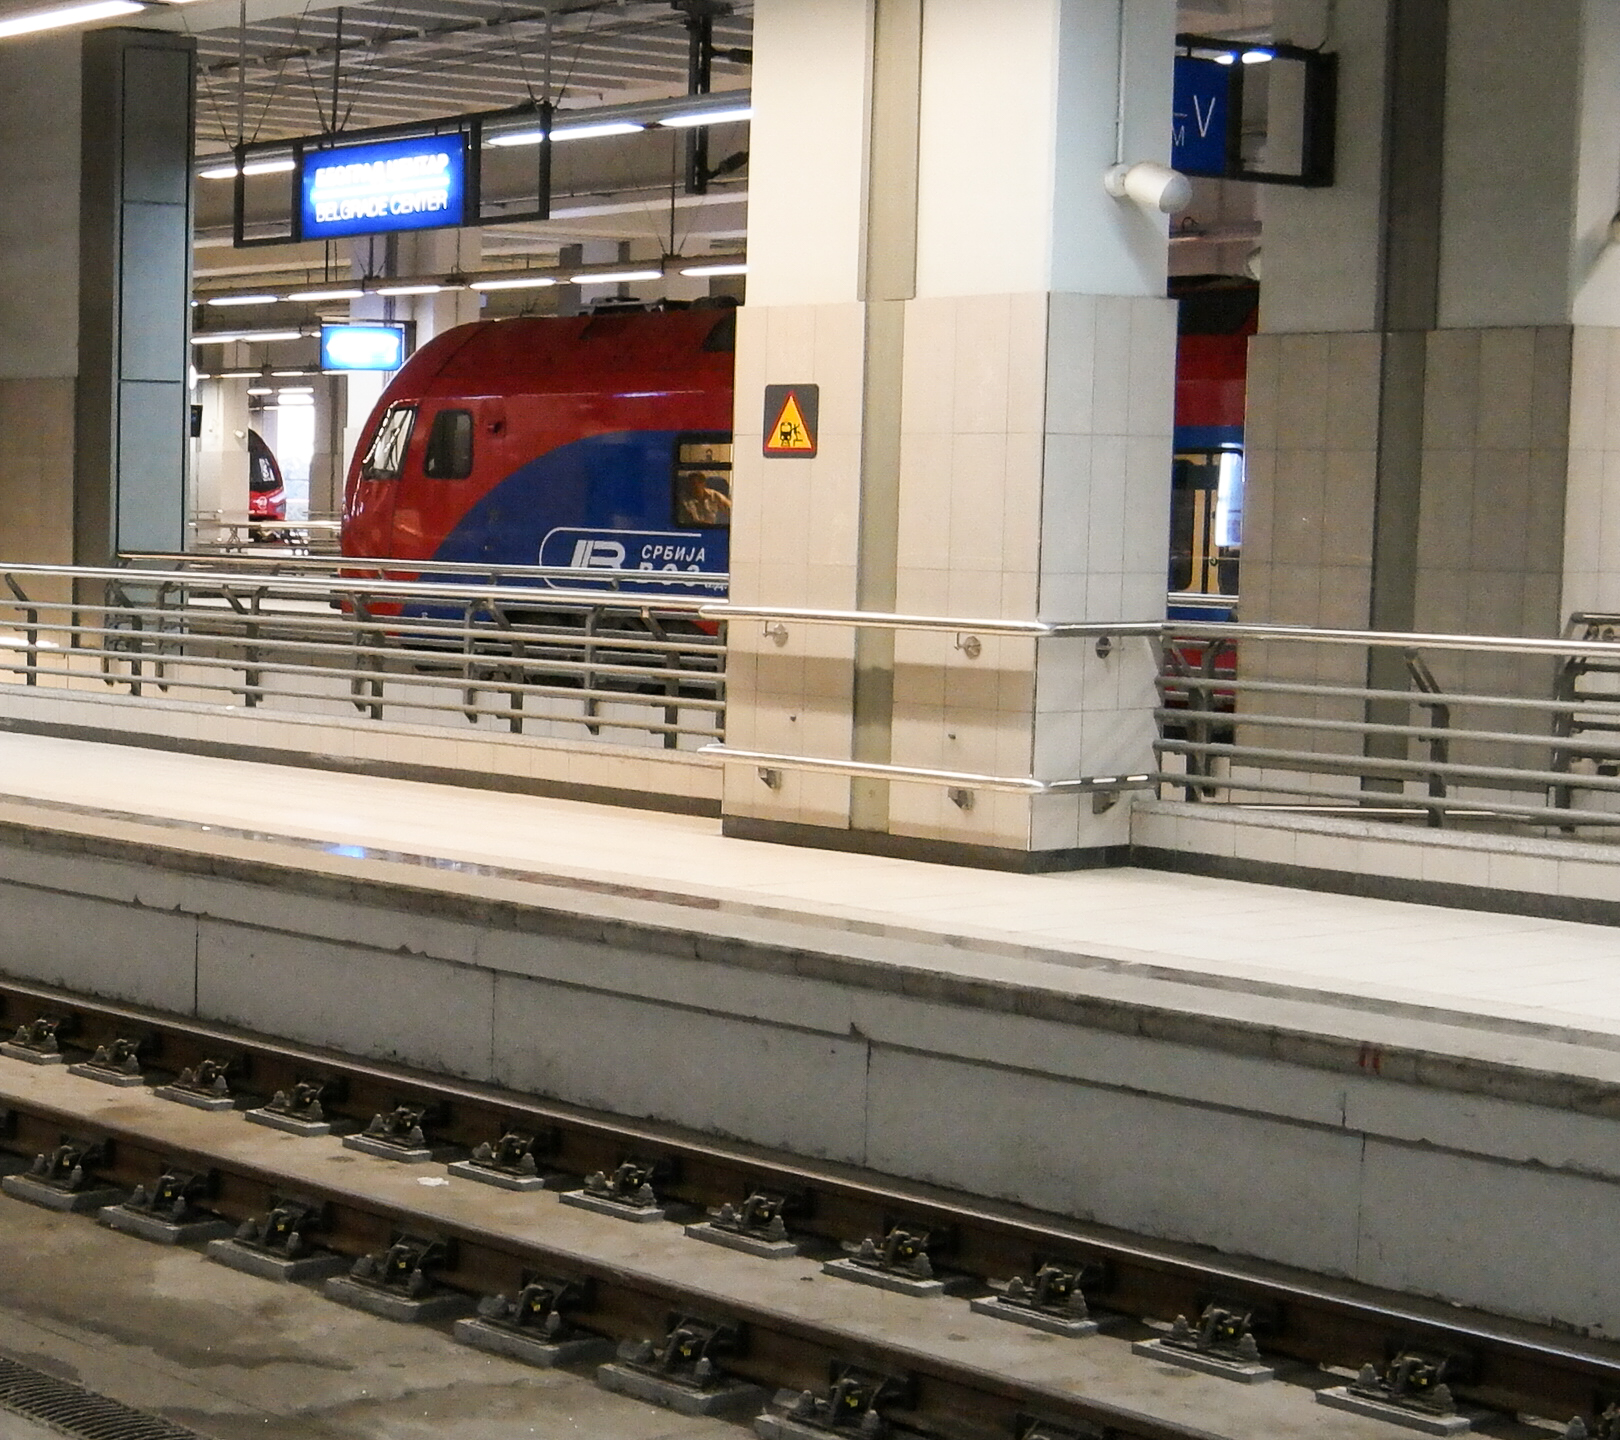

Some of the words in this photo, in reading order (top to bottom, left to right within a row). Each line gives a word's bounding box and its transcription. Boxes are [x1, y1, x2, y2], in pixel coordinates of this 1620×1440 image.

[315, 197, 389, 223] BELGRADE
[390, 190, 448, 215] CENTER
[641, 544, 706, 563] СРБИЈА
